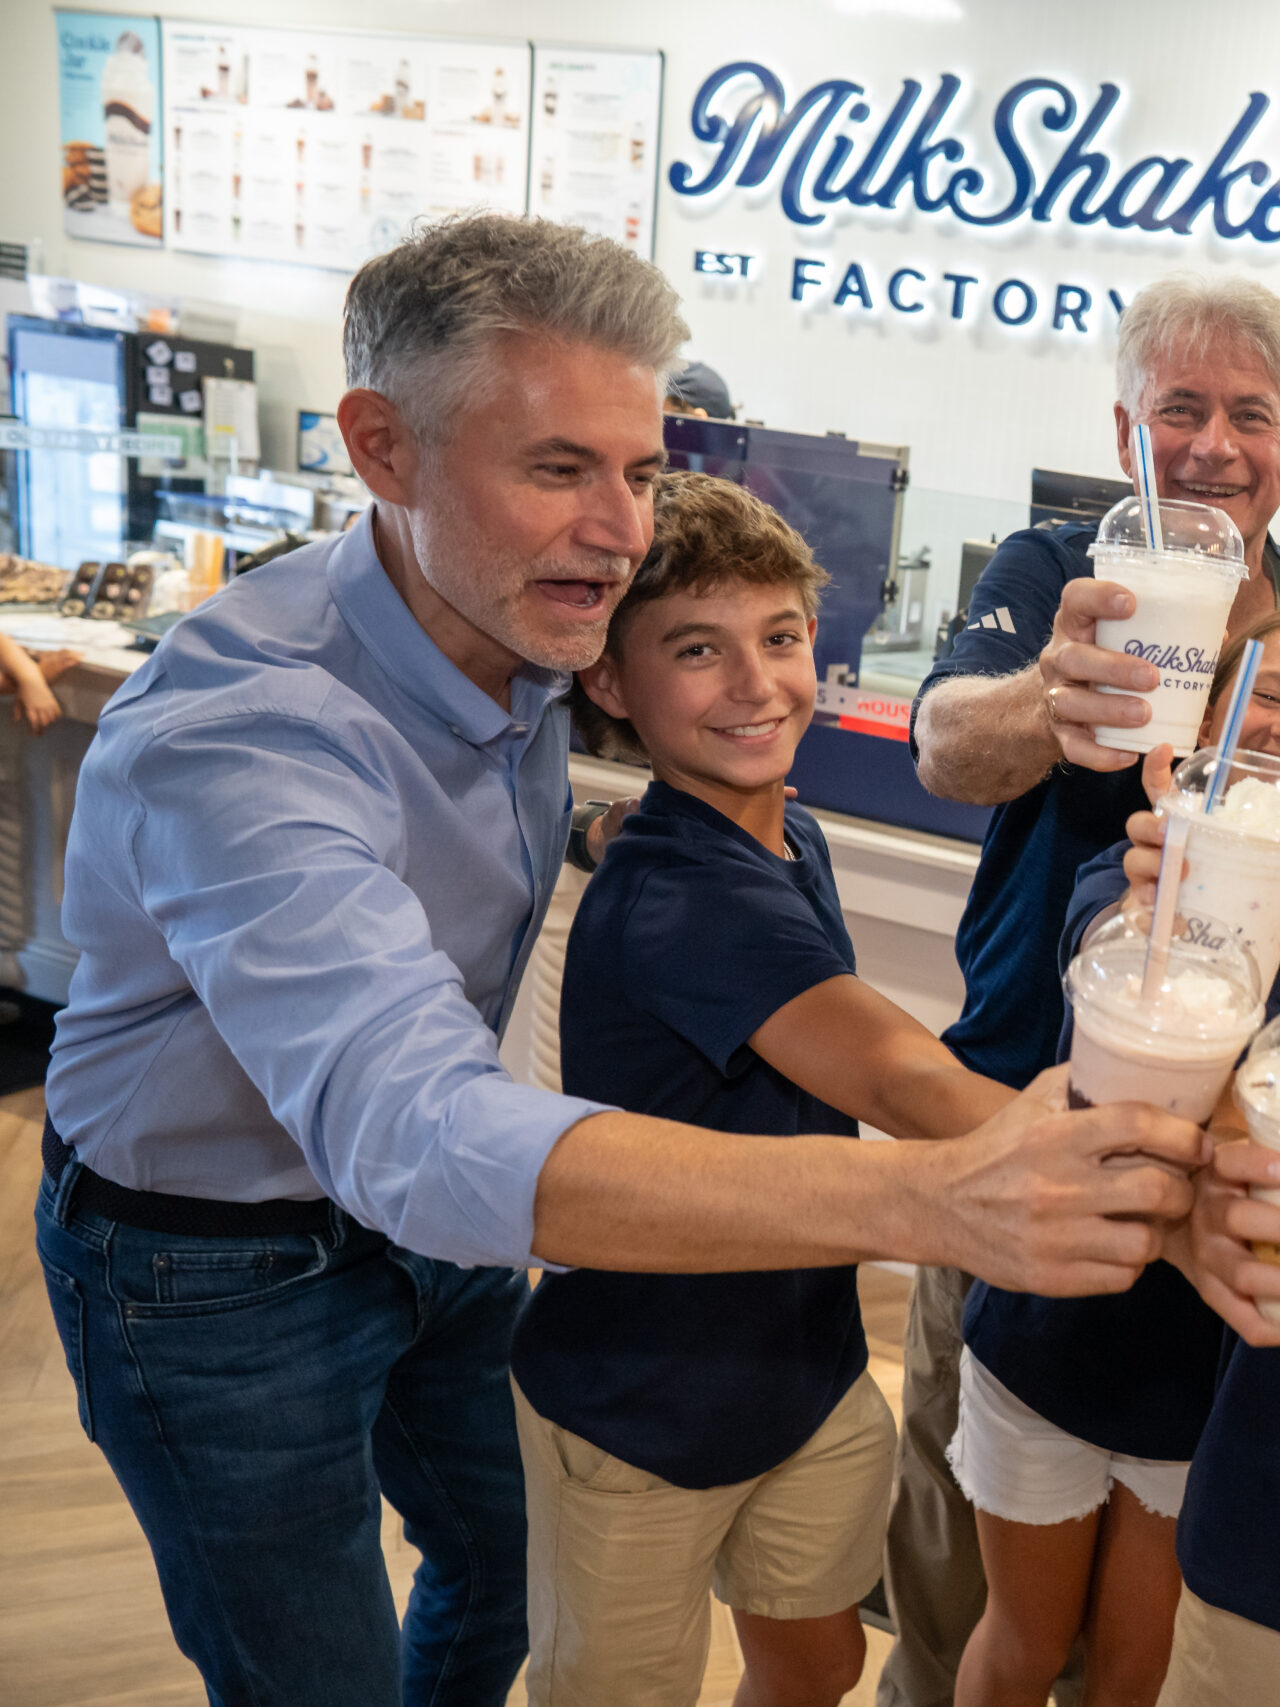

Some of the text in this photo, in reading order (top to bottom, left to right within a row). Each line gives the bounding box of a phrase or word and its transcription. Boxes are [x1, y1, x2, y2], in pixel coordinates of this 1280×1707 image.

[694, 250, 757, 277] EST
[1124, 638, 1218, 676] MilkShak
[1157, 678, 1204, 691] CTORY
